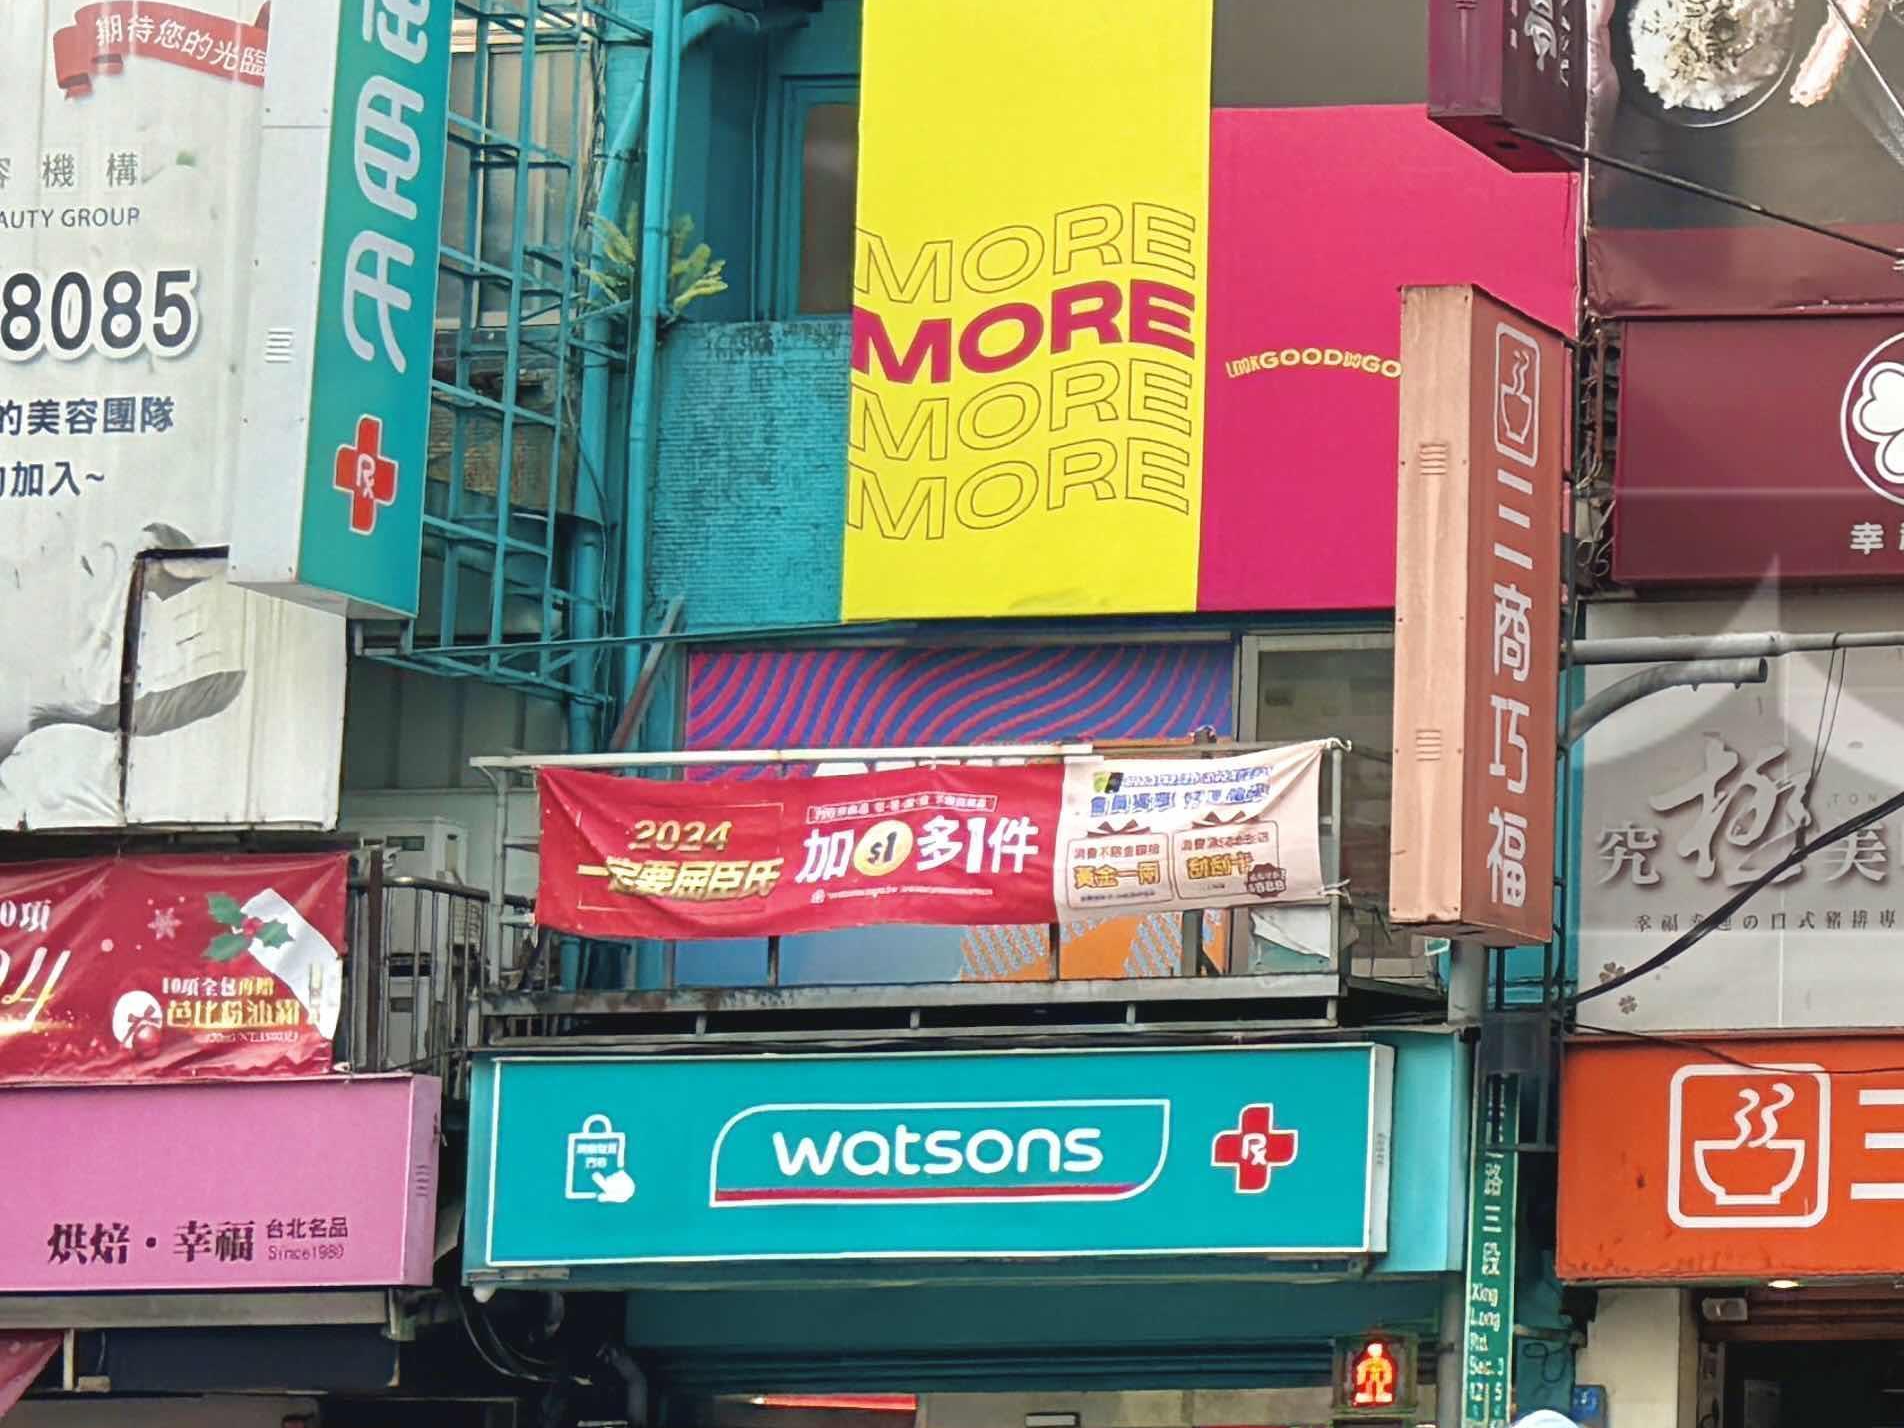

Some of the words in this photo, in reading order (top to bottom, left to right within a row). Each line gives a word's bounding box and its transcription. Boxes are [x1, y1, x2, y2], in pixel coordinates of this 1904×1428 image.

[61, 206, 140, 228] GROUP
[853, 202, 1197, 303] MORE
[1, 269, 192, 351] 8085
[851, 281, 1195, 384] MORE
[850, 358, 1193, 461] MORE
[847, 438, 1189, 541] MORE
[1486, 467, 1535, 909] 三商巧福
[627, 818, 732, 853] 2024
[772, 1123, 1104, 1176] watsons
[265, 1216, 349, 1240] 台北名品
[1471, 1309, 1500, 1332] Long
[1472, 1283, 1499, 1308] Xing
